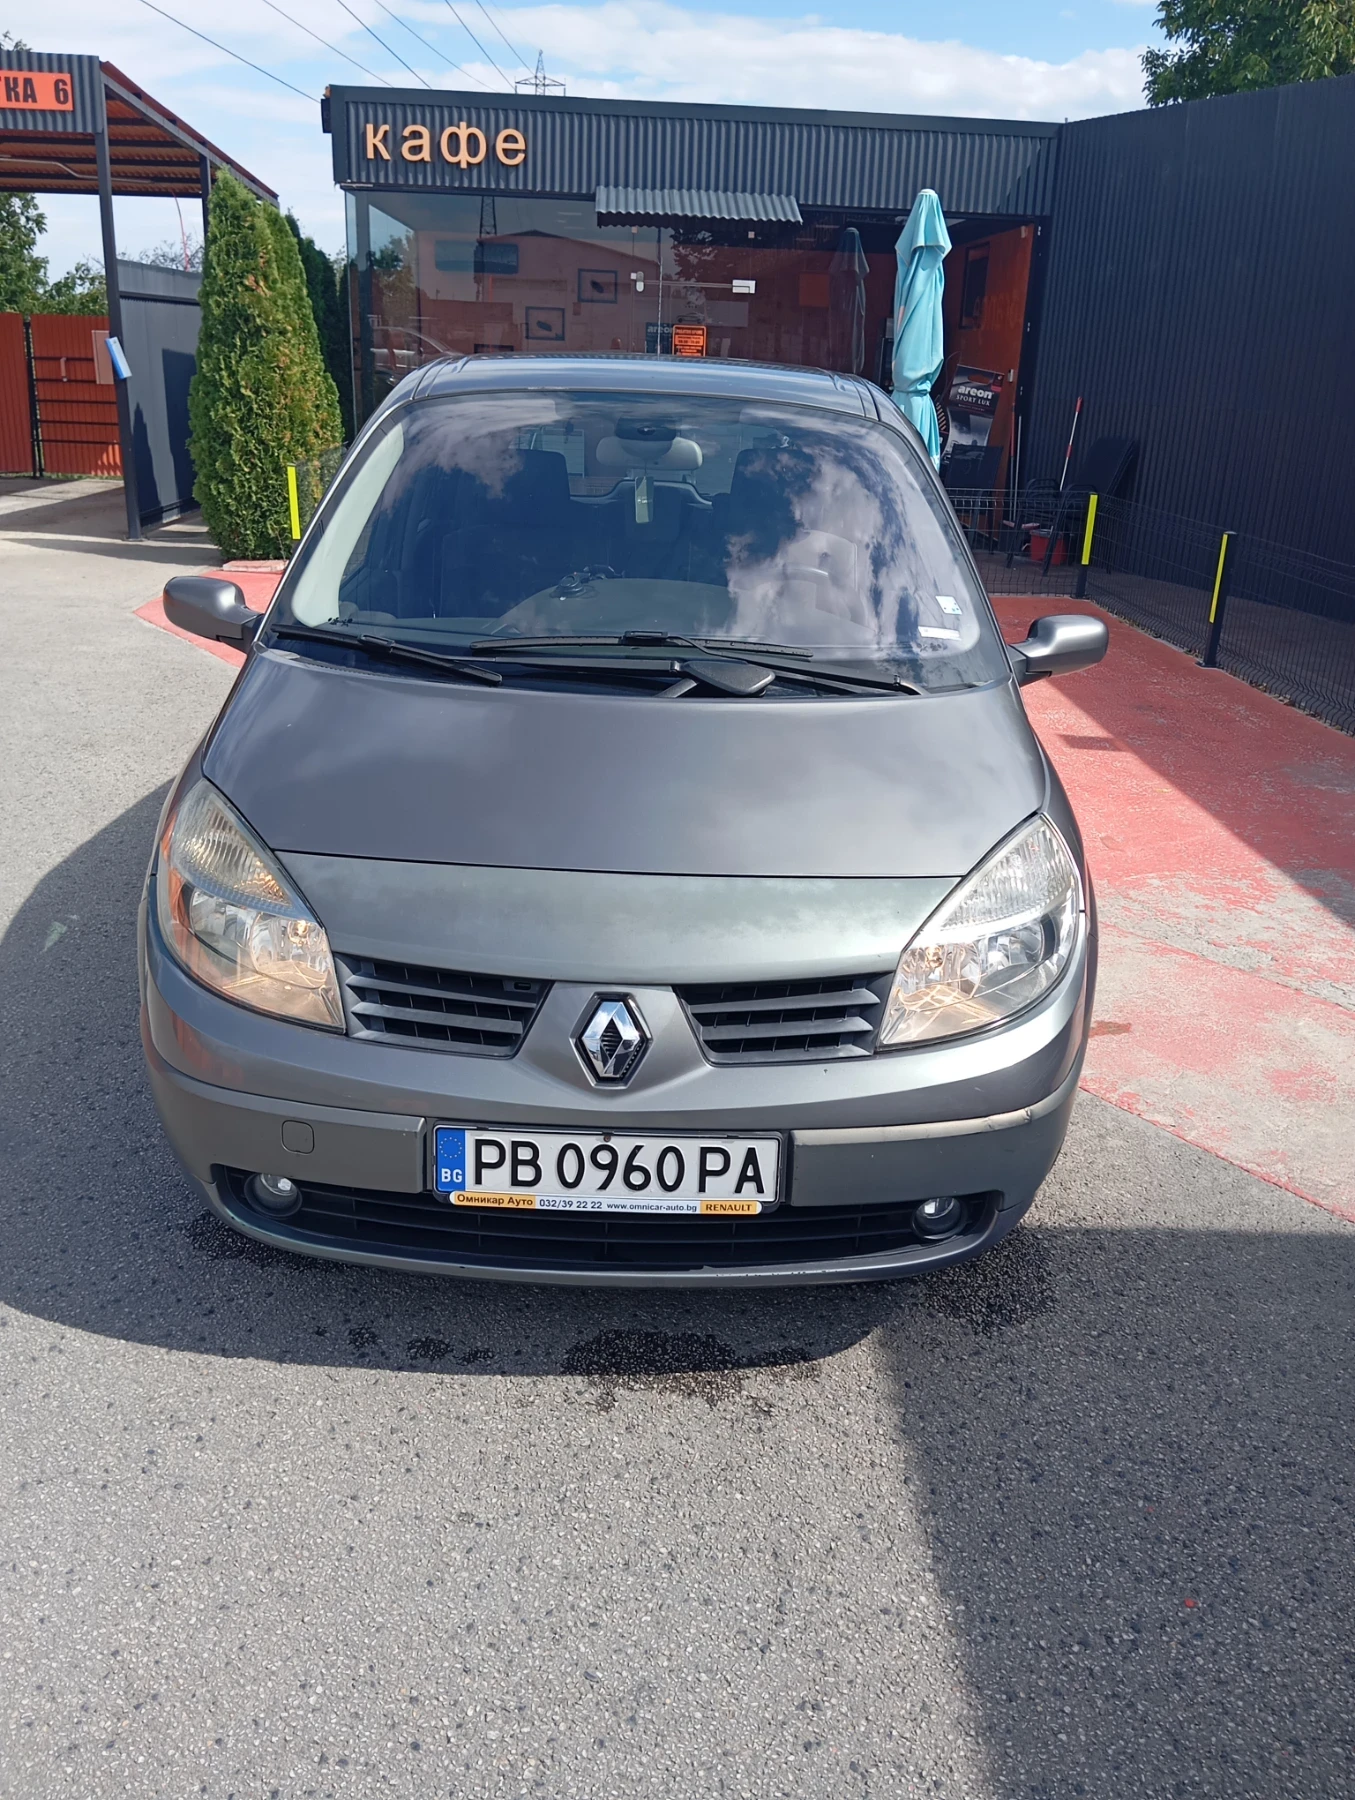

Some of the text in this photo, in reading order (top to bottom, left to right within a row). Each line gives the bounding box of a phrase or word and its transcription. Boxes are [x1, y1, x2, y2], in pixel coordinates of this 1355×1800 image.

[0, 76, 69, 105] КА 6
[365, 121, 526, 169] кафе
[956, 394, 976, 403] SPORT
[957, 385, 994, 400] areon
[441, 1168, 463, 1183] BG
[474, 1138, 765, 1194] PB 0960 PA
[457, 1193, 753, 1213] Омникар Ауто 032/39 22 22 www.omnicar-auto.bg RENAULT
